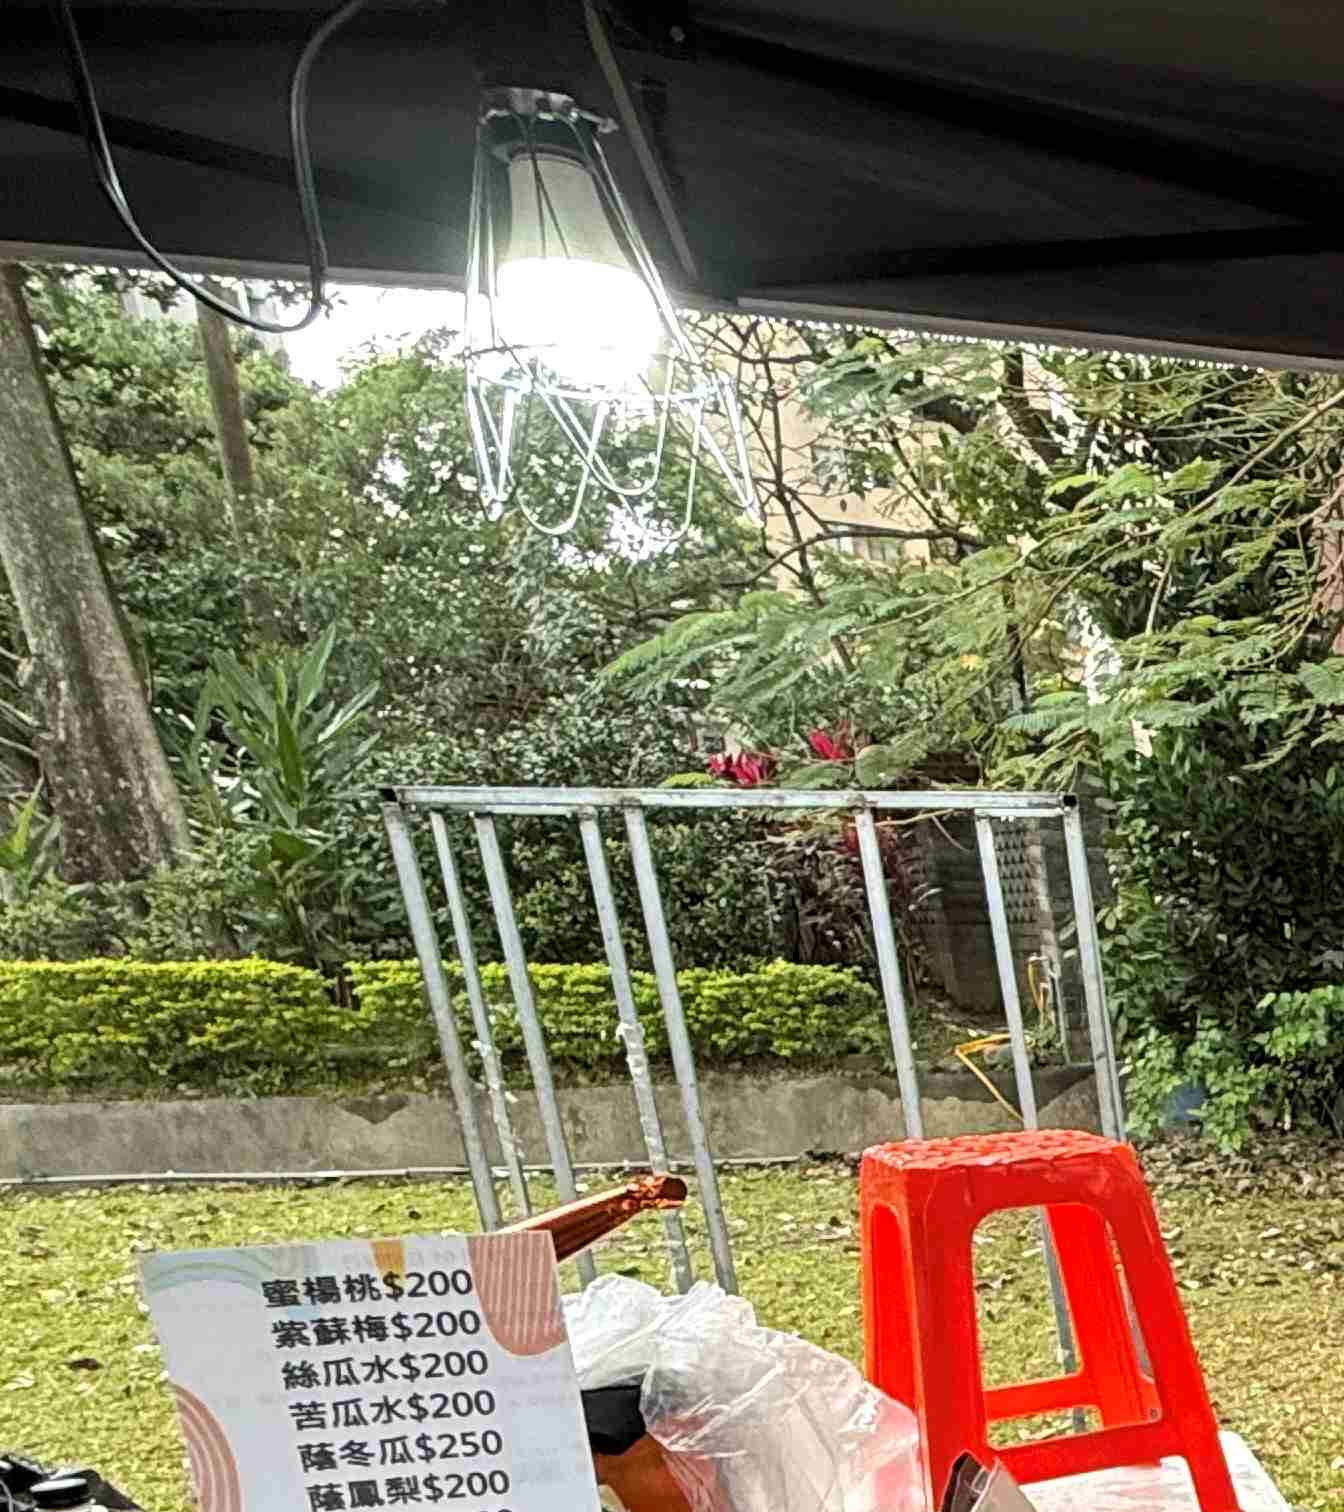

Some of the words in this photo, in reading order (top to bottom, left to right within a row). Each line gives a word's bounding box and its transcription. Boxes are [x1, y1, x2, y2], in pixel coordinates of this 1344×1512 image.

[262, 1269, 473, 1308] 蜜楊桃$200
[272, 1309, 480, 1349] 紫蘇梅$200
[281, 1349, 489, 1390] 絲瓜水$200
[288, 1389, 496, 1431] 苦瓜水$200
[297, 1430, 503, 1473] 蔭冬瓜$250
[306, 1470, 510, 1512] 蔭鳳梨$200
